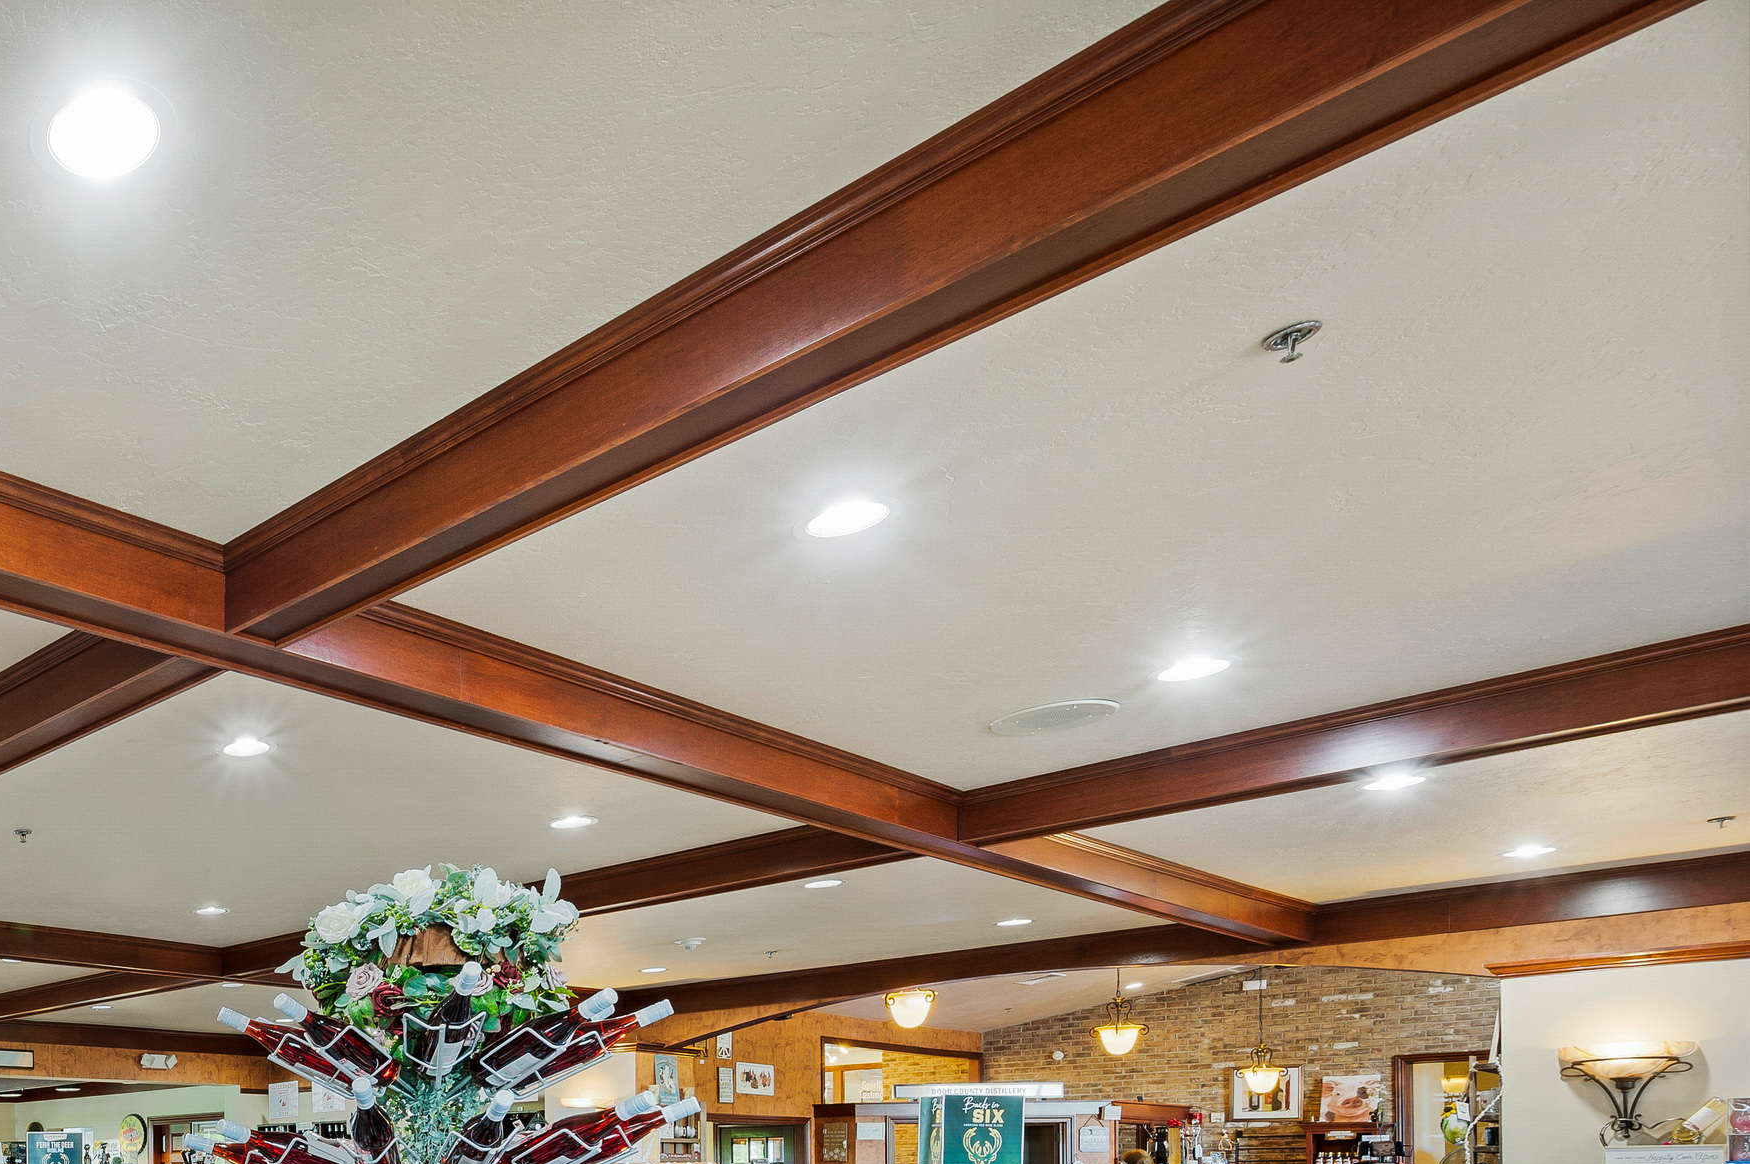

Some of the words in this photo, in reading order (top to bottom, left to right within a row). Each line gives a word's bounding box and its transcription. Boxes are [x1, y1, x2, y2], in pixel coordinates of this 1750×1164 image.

[985, 1087, 1027, 1095] DISTILLERY
[972, 1108, 1005, 1124] SIX
[35, 1141, 50, 1149] FEAR
[51, 1141, 60, 1149] THE
[61, 1141, 75, 1149] DEER
[1647, 1151, 1674, 1164] Happily
[1675, 1151, 1693, 1161] Ever
